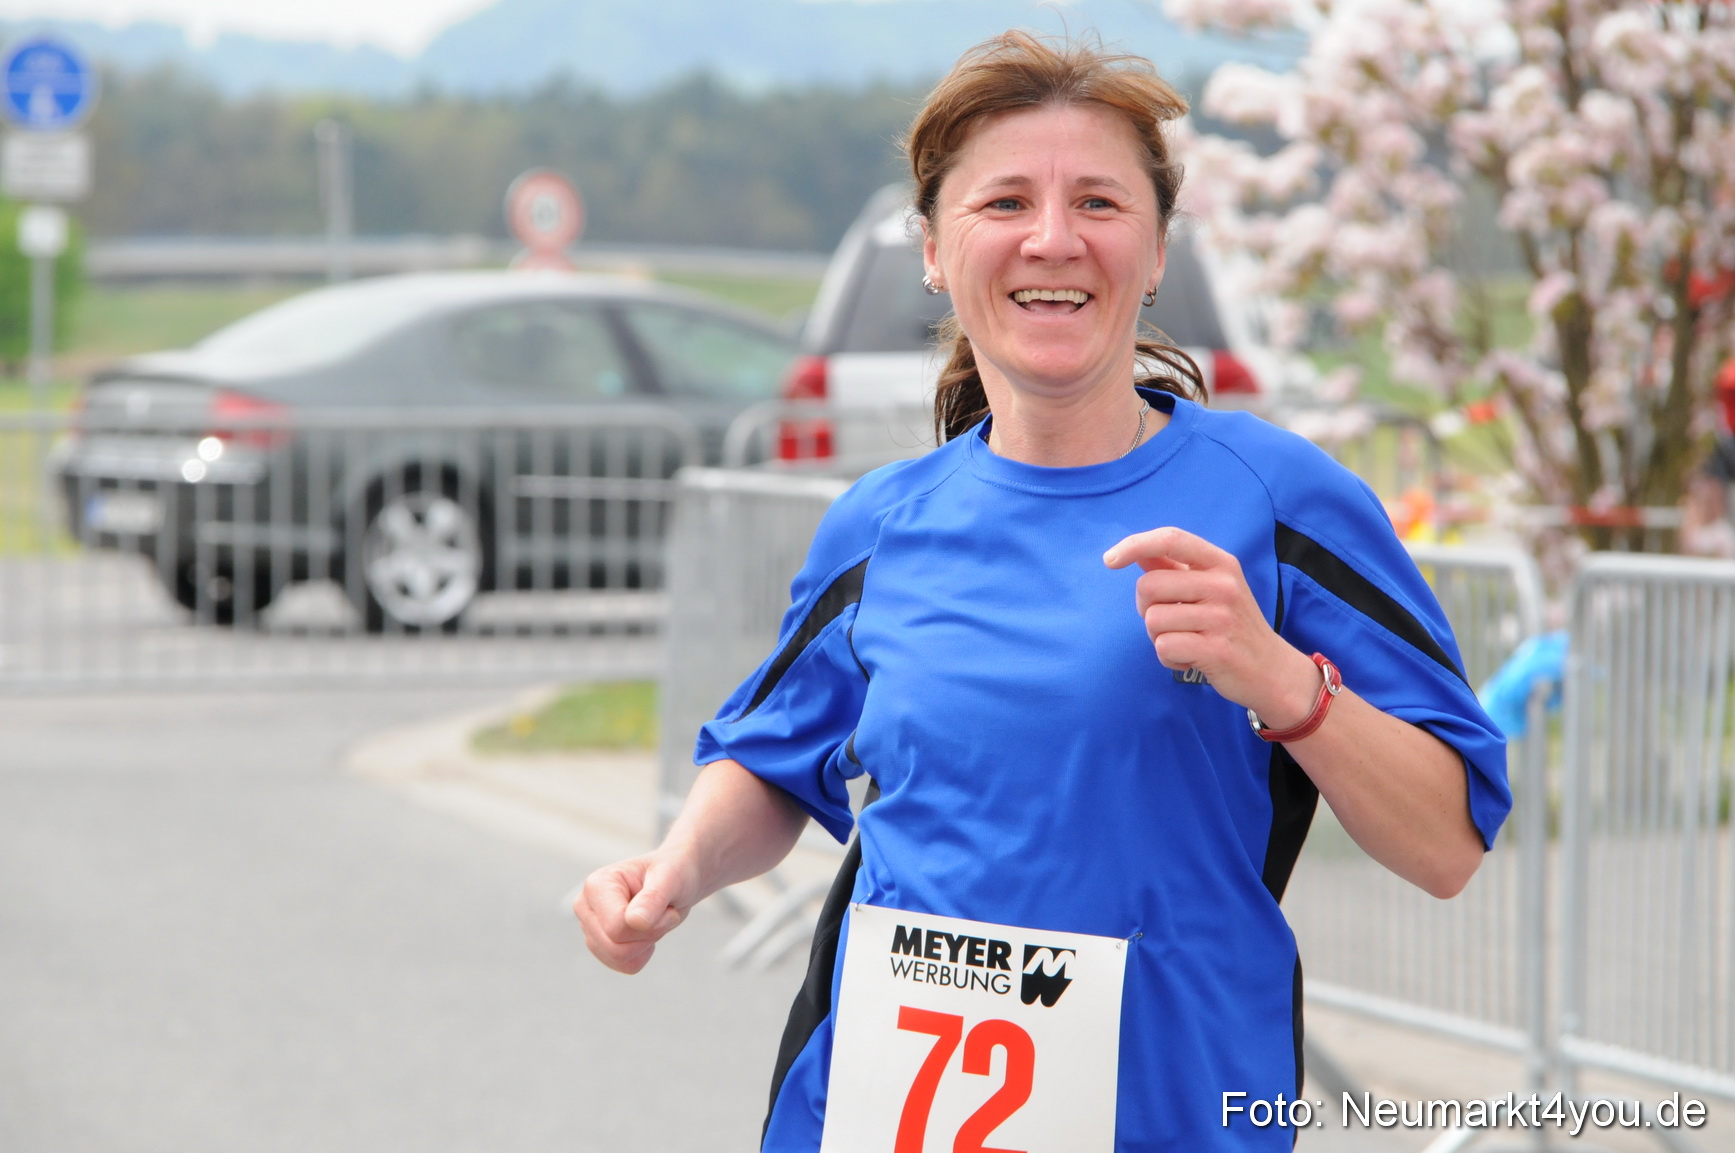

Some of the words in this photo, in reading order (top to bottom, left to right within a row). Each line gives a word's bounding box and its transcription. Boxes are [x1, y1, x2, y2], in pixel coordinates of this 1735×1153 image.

[891, 925, 1012, 971] MEYER
[890, 957, 1012, 995] WERBUNG
[893, 1005, 1036, 1153] 72
